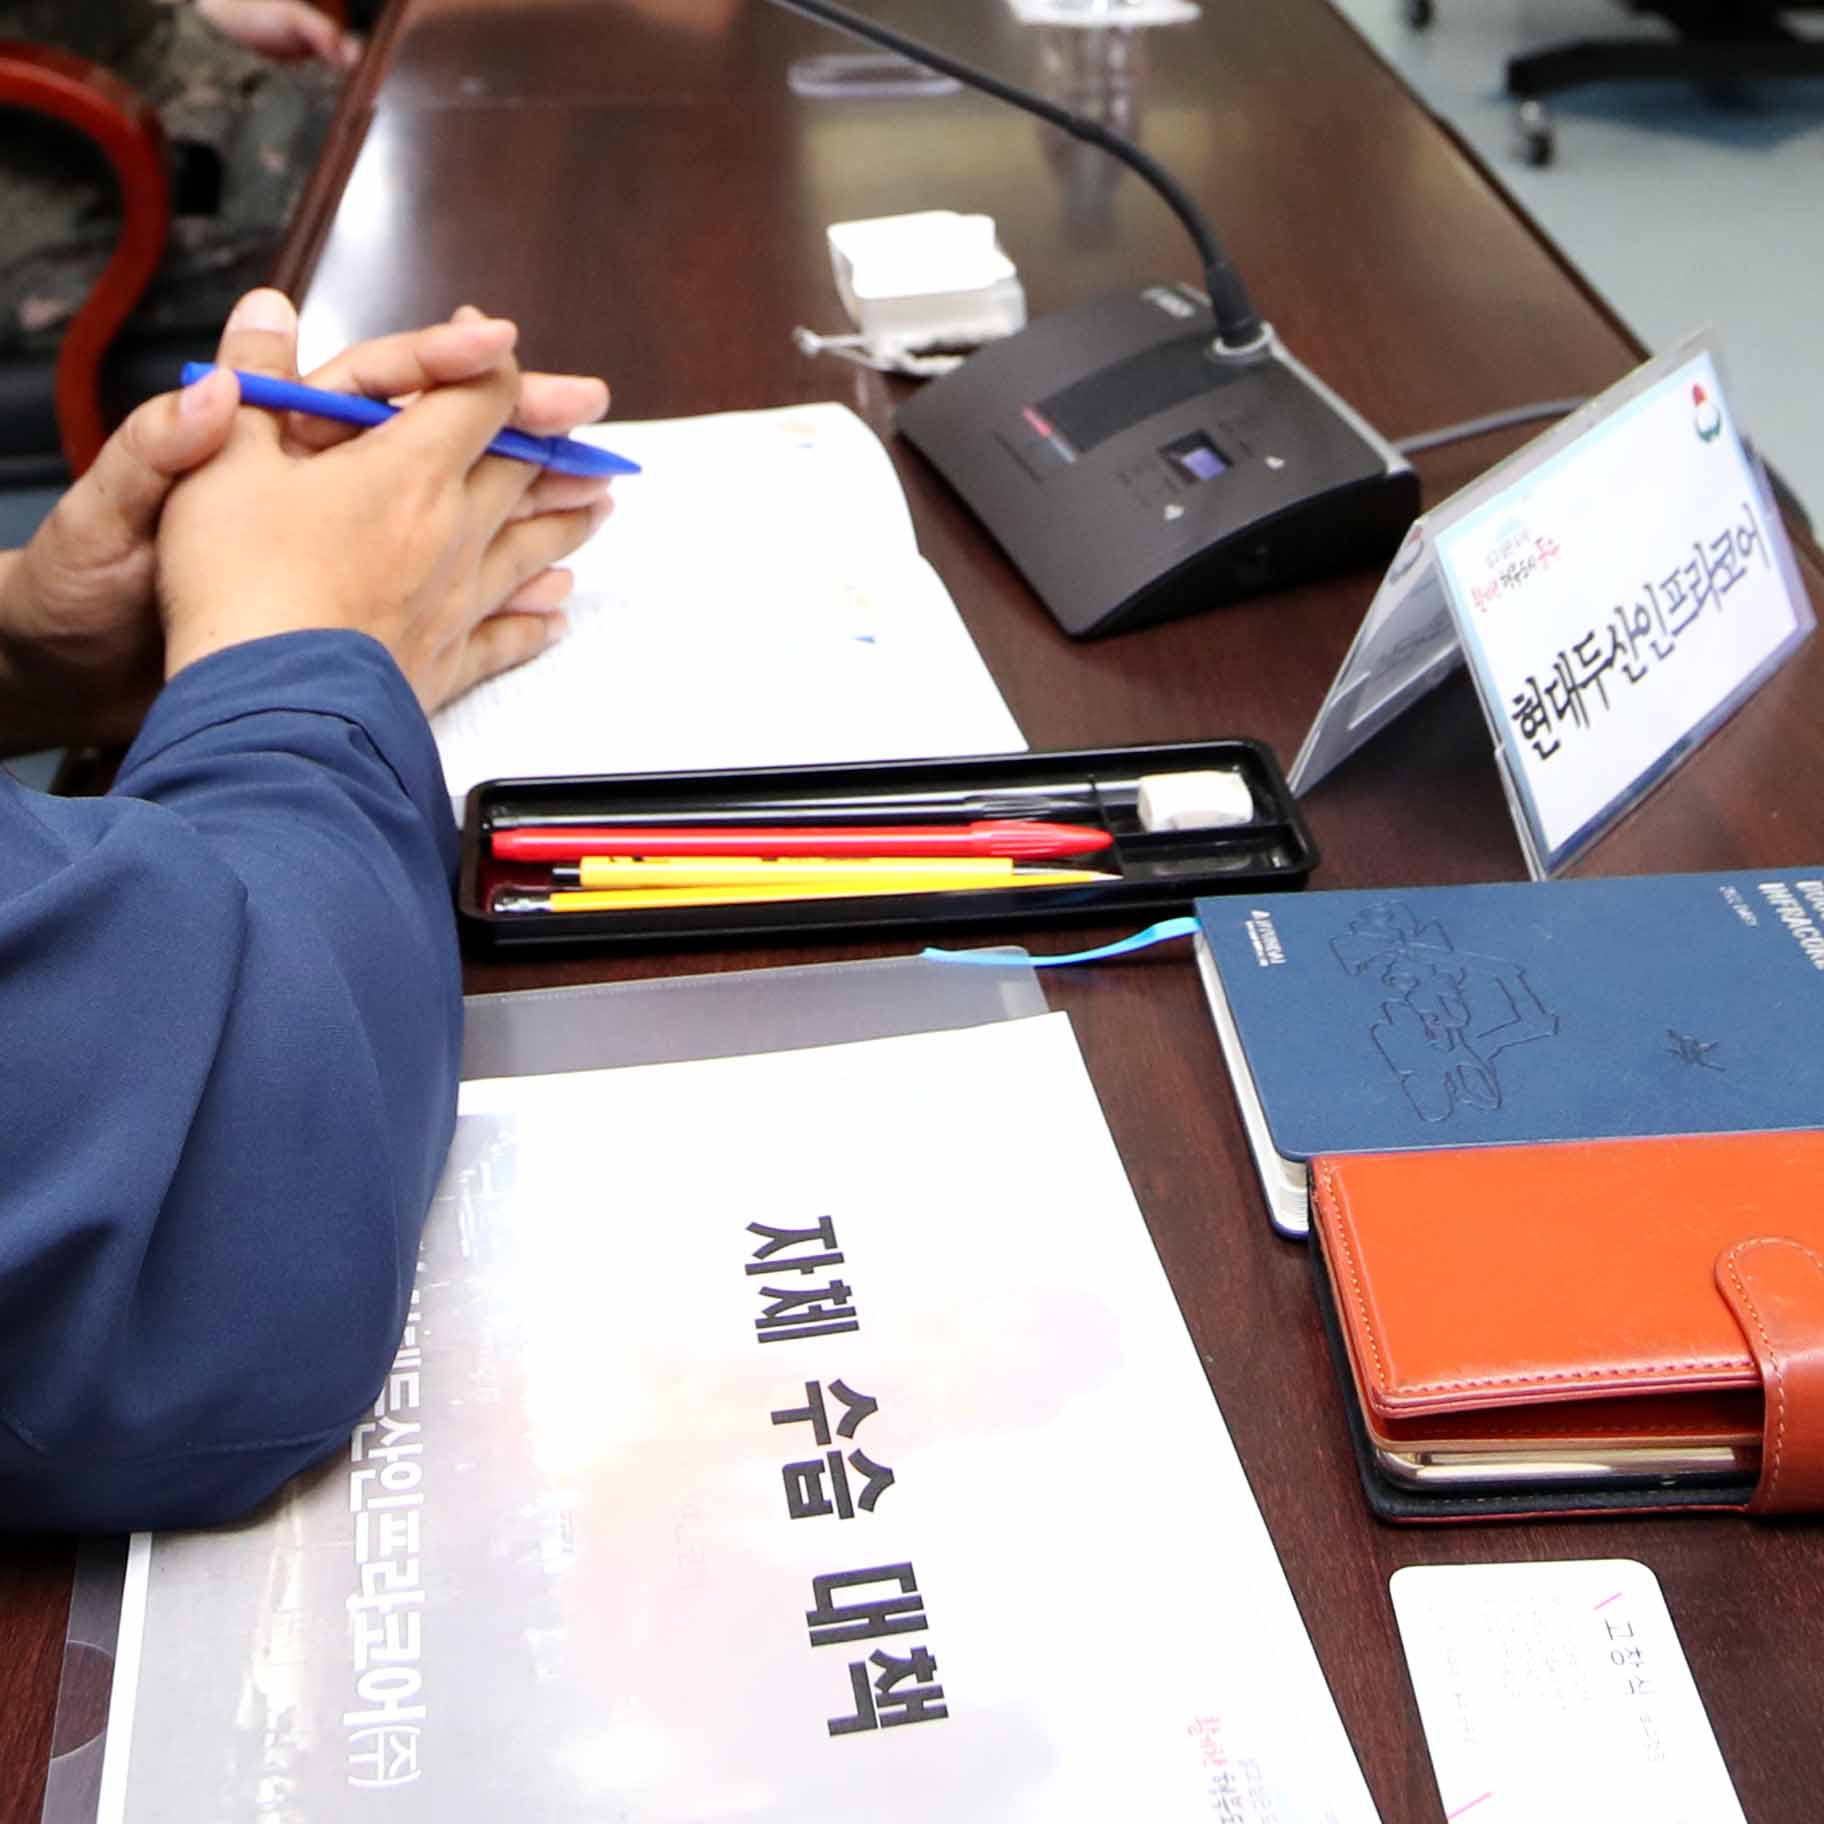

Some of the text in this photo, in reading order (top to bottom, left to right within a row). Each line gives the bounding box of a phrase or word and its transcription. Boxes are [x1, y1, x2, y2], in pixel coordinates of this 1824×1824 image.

[1511, 501, 1771, 760] 현대두산인프라코어
[745, 1215, 950, 1737] 자체 수습 대책
